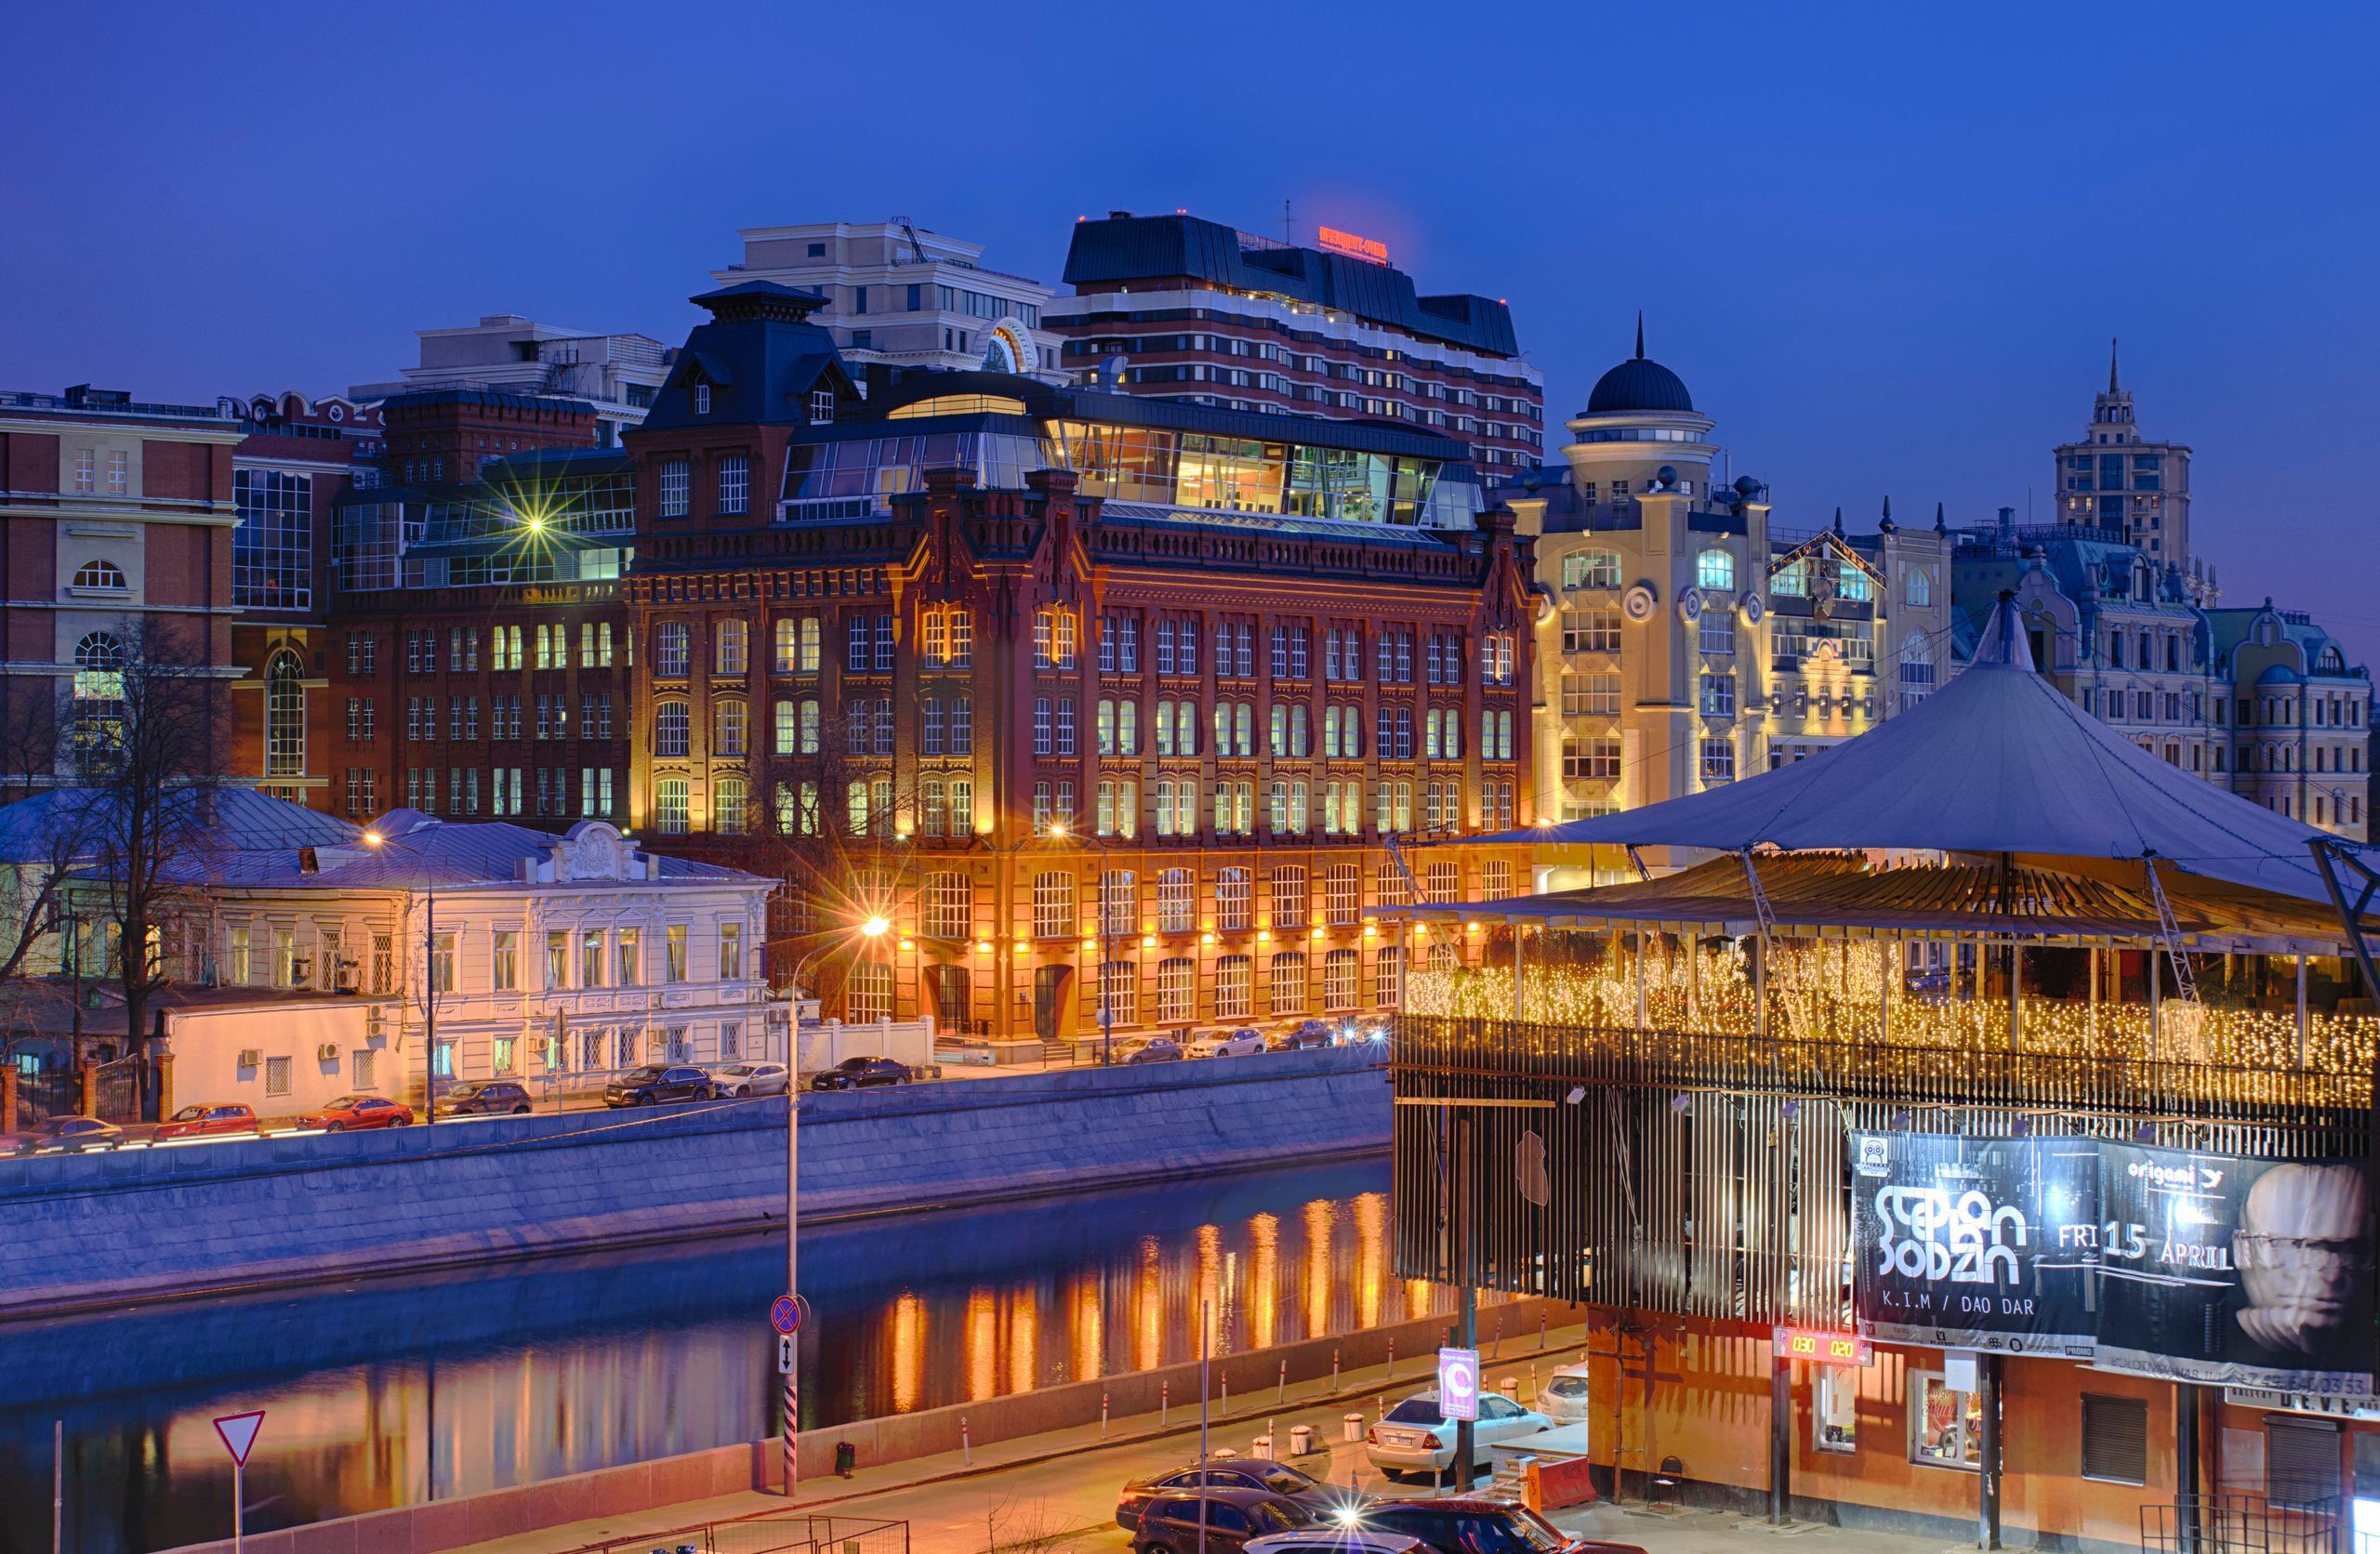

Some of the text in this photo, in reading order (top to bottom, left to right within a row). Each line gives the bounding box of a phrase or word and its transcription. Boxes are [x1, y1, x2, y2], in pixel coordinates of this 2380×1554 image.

[1319, 226, 1388, 258] ПРЕЗИДЕНТ-ОТЕЛЬ
[2127, 1159, 2196, 1186] origami
[2057, 1220, 2234, 1271] FRI 15 APRIL
[1883, 1290, 1931, 1310] K.I.M
[1962, 1296, 1990, 1314] DAO
[2003, 1298, 2034, 1316] DAR
[1792, 1336, 1816, 1353] 030
[1831, 1340, 1854, 1358] 020
[2066, 1347, 2092, 1356] PROMO
[2231, 1388, 2272, 1399] GALLERY
[2320, 1377, 2341, 1393] 03
[2345, 1379, 2364, 1394] 53
